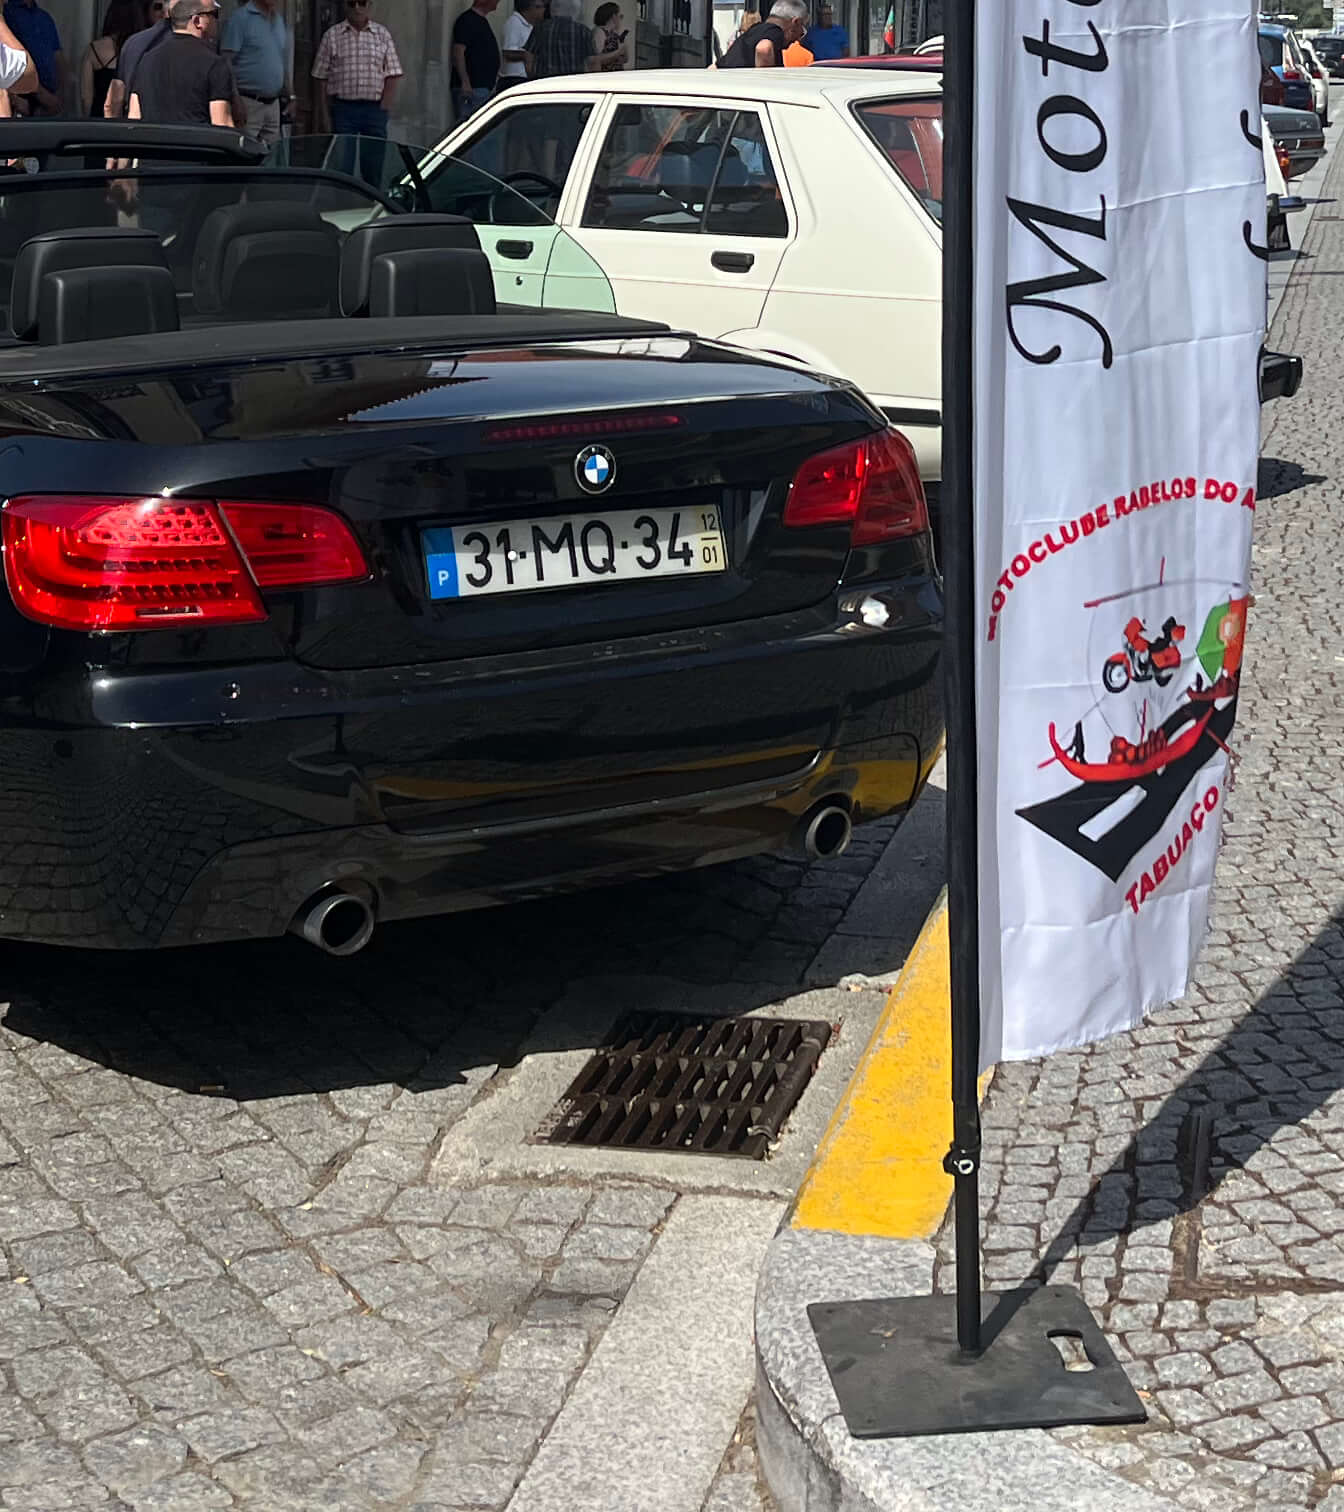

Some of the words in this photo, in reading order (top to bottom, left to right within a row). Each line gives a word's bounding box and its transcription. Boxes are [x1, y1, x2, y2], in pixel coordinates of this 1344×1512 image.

[1114, 477, 1196, 519] RABELOS
[1204, 478, 1238, 503] DO
[700, 513, 718, 531] 12
[702, 545, 718, 564] 01
[437, 571, 450, 587] P
[1124, 786, 1219, 914] TABUAÇO
